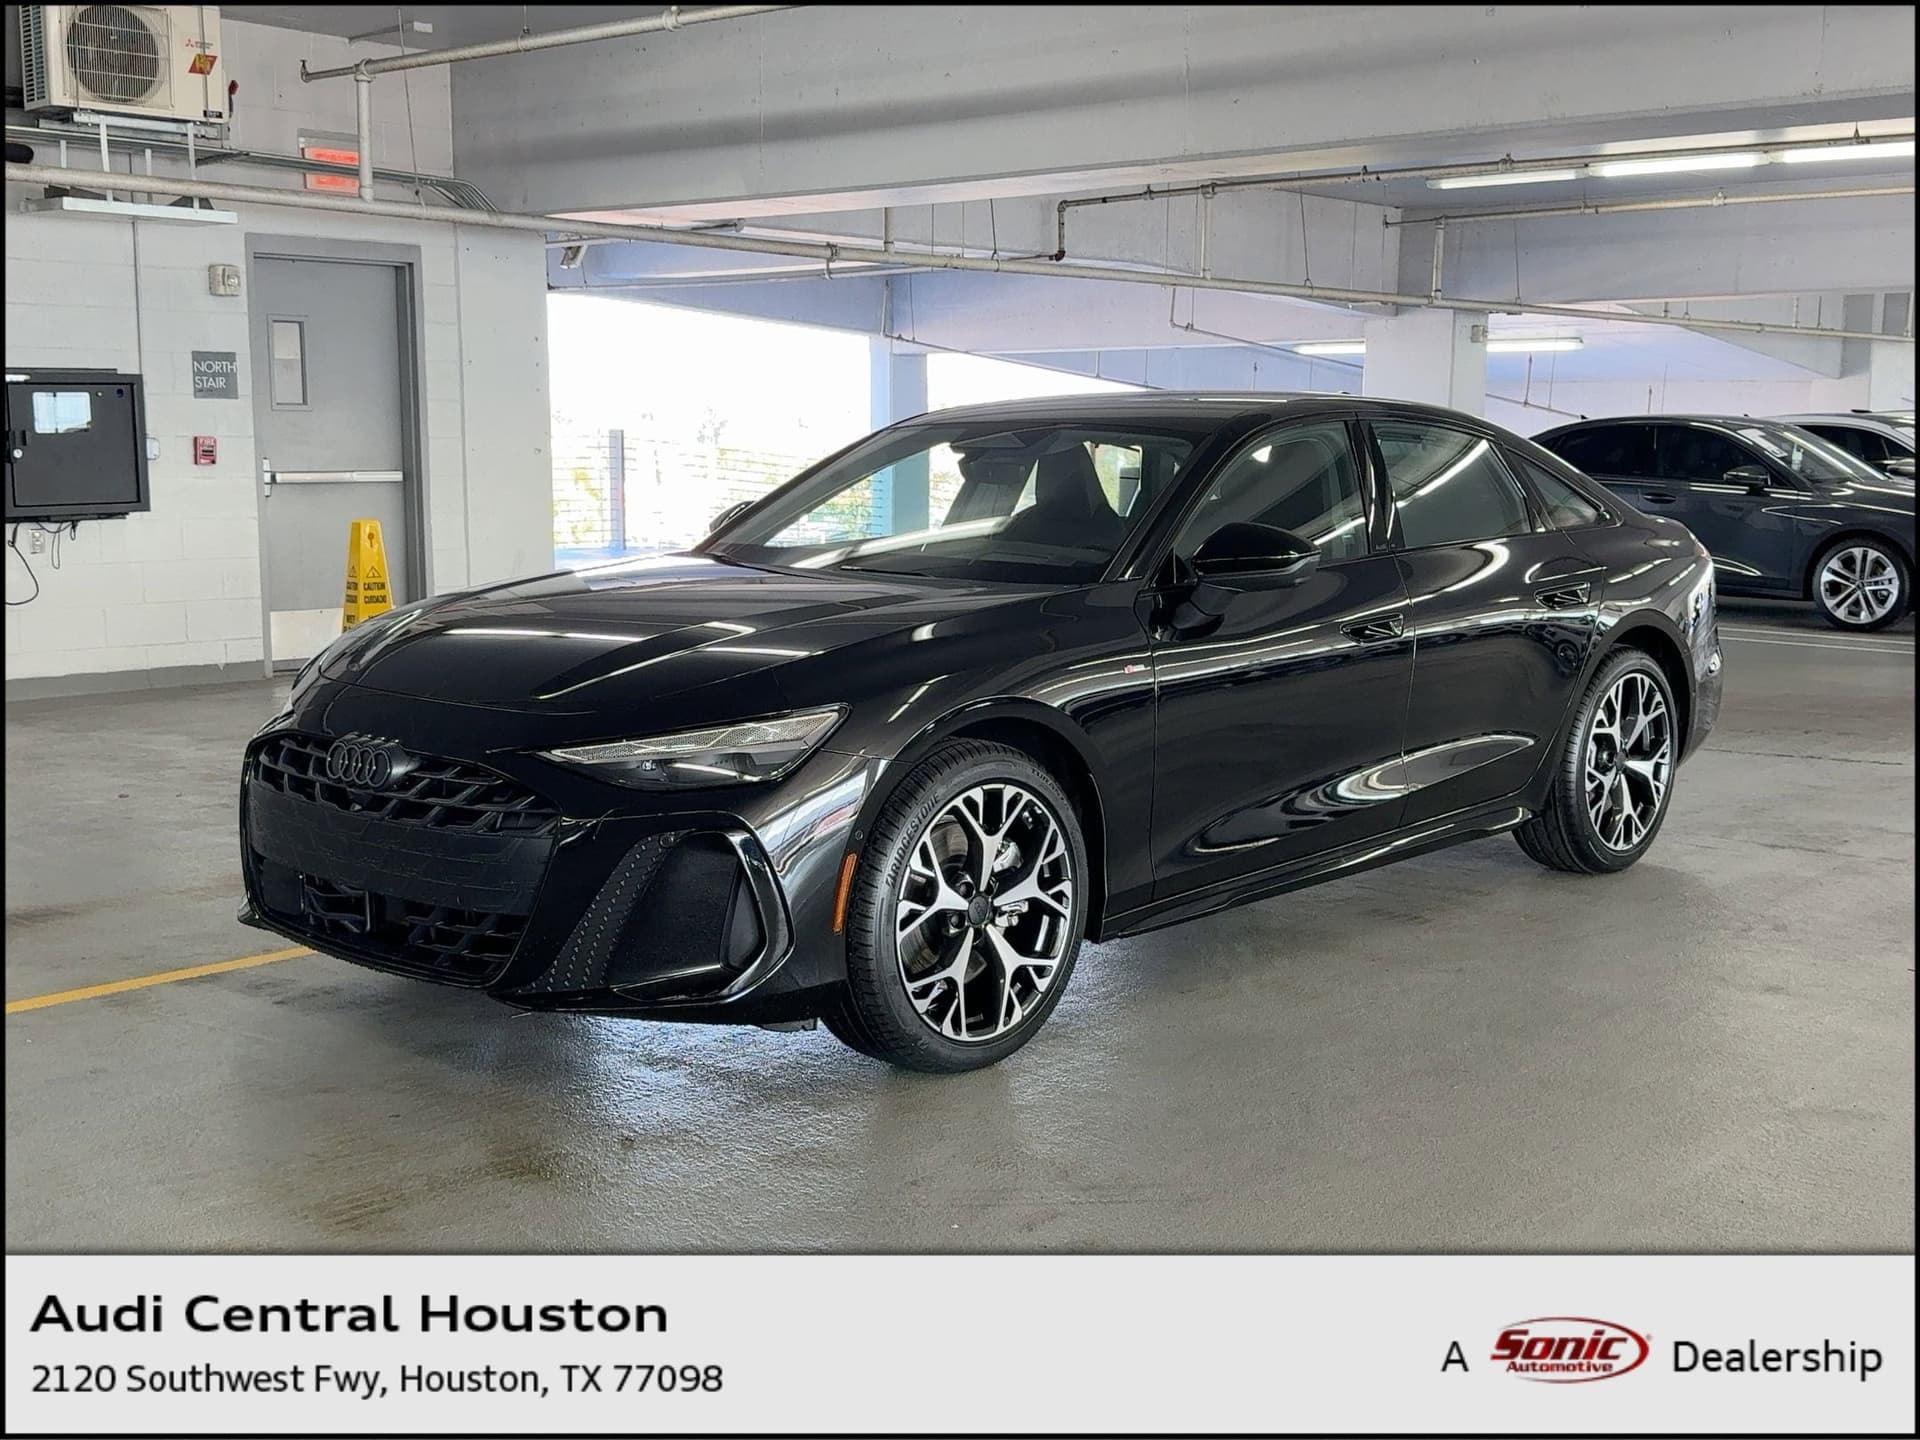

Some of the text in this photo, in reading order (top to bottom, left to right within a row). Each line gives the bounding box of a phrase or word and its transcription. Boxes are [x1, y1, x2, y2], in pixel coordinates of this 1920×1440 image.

[193, 360, 237, 373] NORTH
[194, 375, 227, 389] STAIR
[363, 581, 386, 591] CAUTION
[363, 595, 387, 604] CUIDADO
[884, 792, 941, 889] BRIDGESTONE
